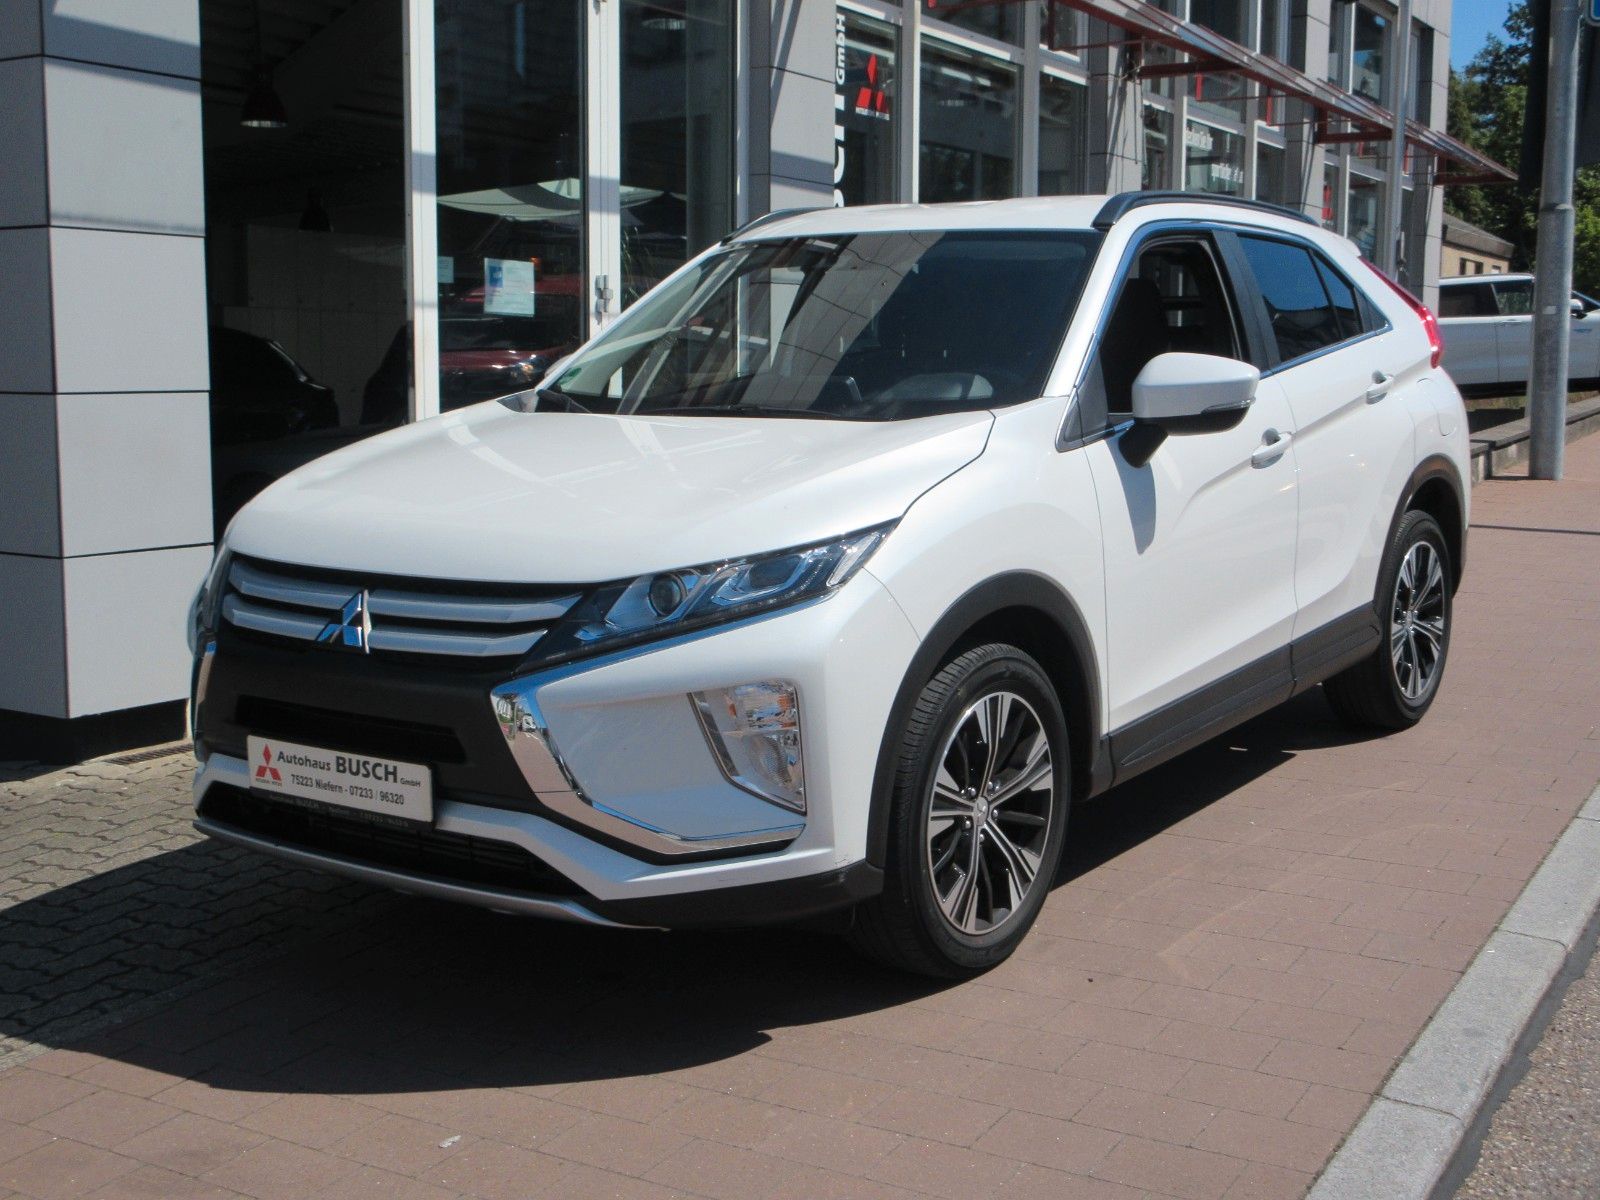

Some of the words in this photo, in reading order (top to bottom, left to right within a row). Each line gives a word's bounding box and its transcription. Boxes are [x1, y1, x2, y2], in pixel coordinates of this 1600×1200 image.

[835, 14, 846, 86] GmbH
[277, 751, 331, 771] Autohaus
[336, 756, 398, 783] BUSCH
[400, 777, 421, 788] GmbH
[291, 774, 313, 788] 75223
[315, 778, 343, 794] Niefern
[350, 785, 373, 799] 07233
[379, 790, 404, 805] 96320
